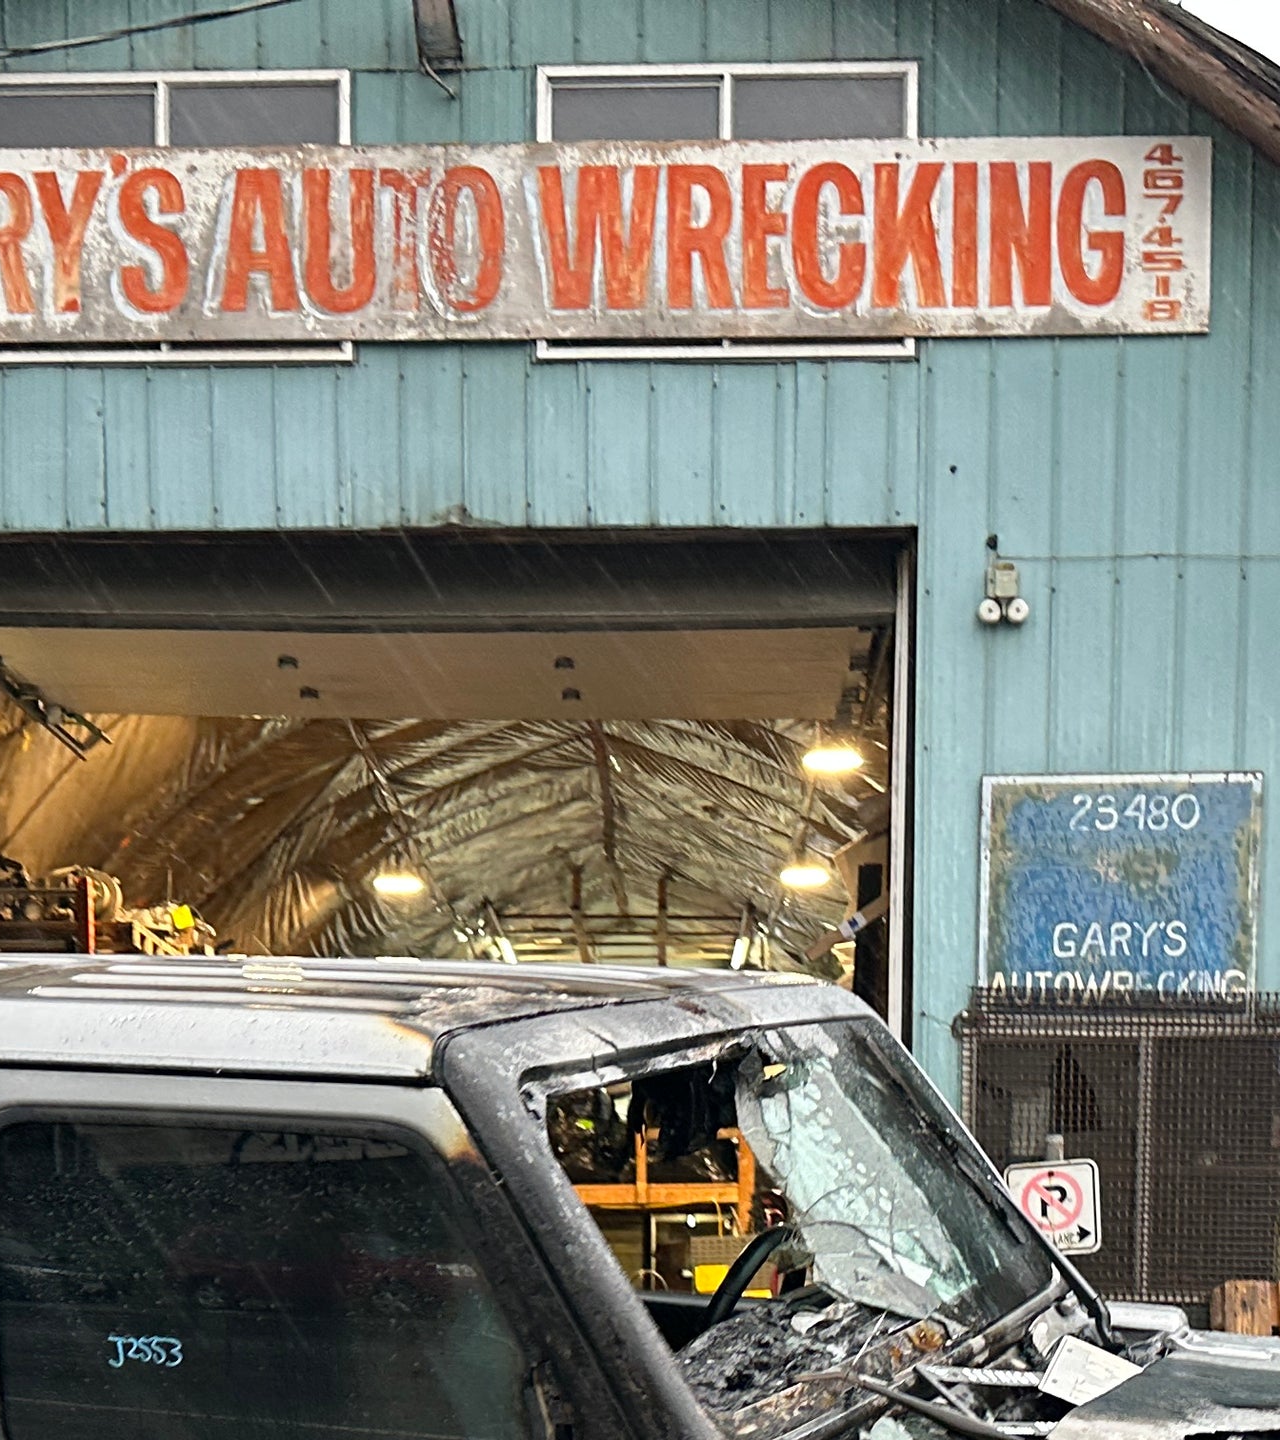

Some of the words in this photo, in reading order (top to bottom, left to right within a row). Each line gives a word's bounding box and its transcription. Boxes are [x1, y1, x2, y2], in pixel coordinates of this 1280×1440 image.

[220, 164, 507, 316] AUTO
[536, 158, 1128, 310] WRECKING
[1069, 793, 1201, 831] 23480
[1052, 920, 1188, 958] GARY'S
[107, 1332, 183, 1368] J2553
